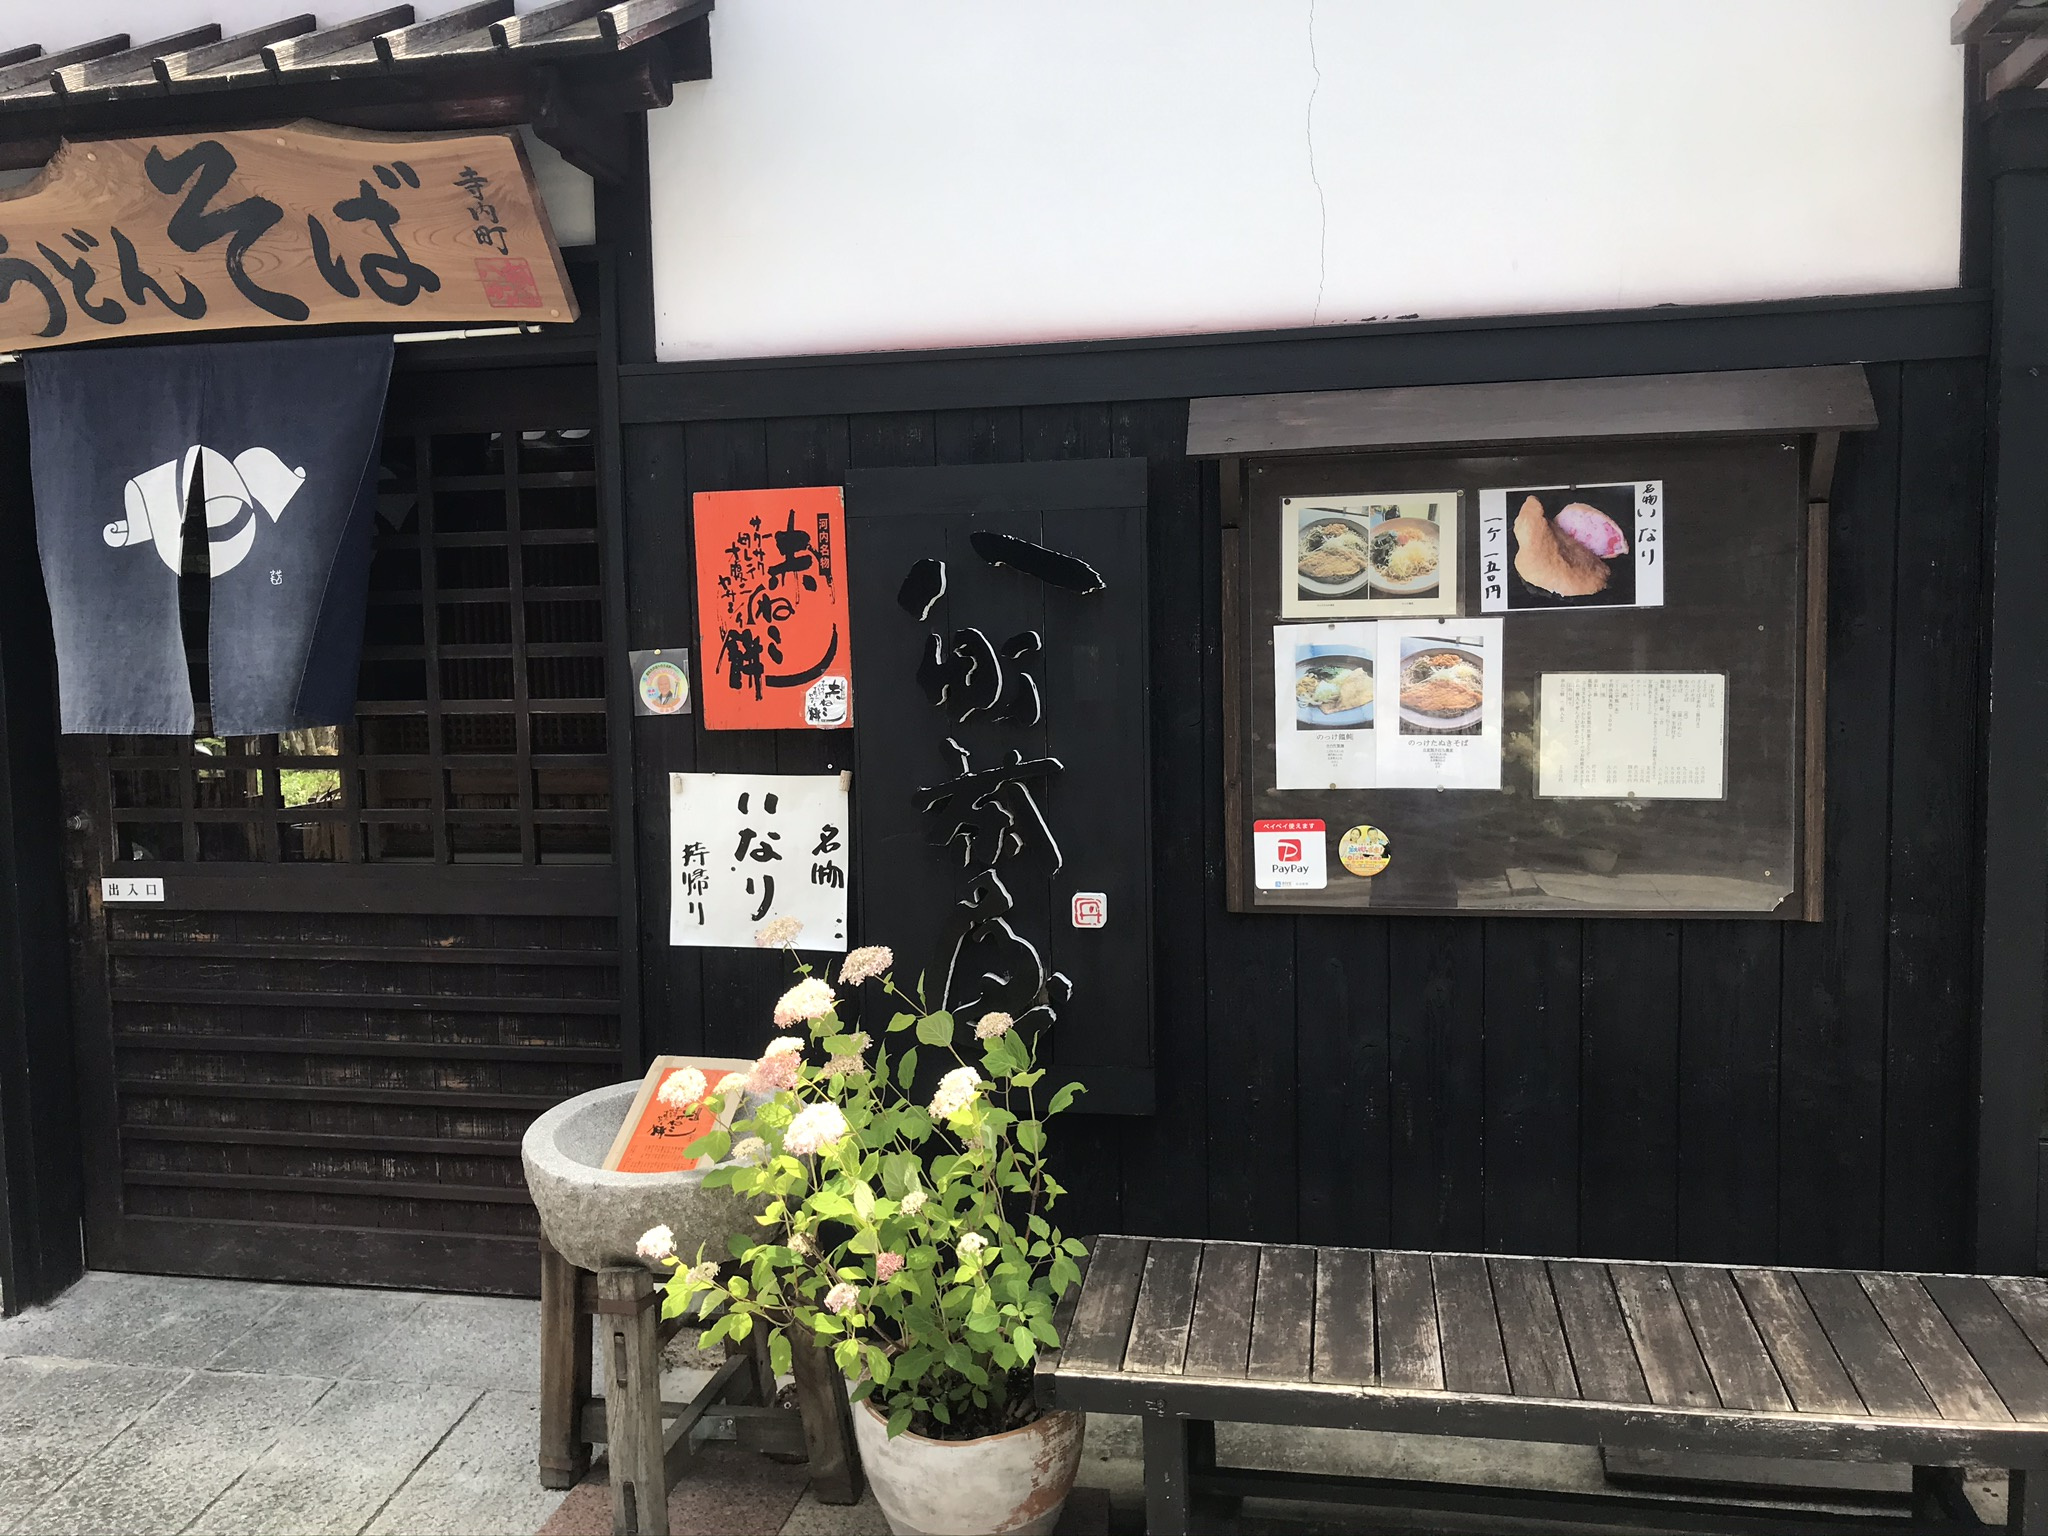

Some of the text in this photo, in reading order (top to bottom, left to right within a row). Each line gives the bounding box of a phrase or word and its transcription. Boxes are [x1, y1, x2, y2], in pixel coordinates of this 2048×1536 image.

[453, 166, 509, 255] 寺内町
[819, 517, 831, 569] 河内名物
[1408, 739, 1469, 747] のっけたぬきそば
[1263, 822, 1315, 830] ペイペイ使えます
[734, 792, 783, 922] いなり
[811, 823, 845, 889] 名物
[1272, 864, 1309, 875] PayPay
[108, 883, 157, 896] 出入口
[682, 841, 711, 926] 持帰り
